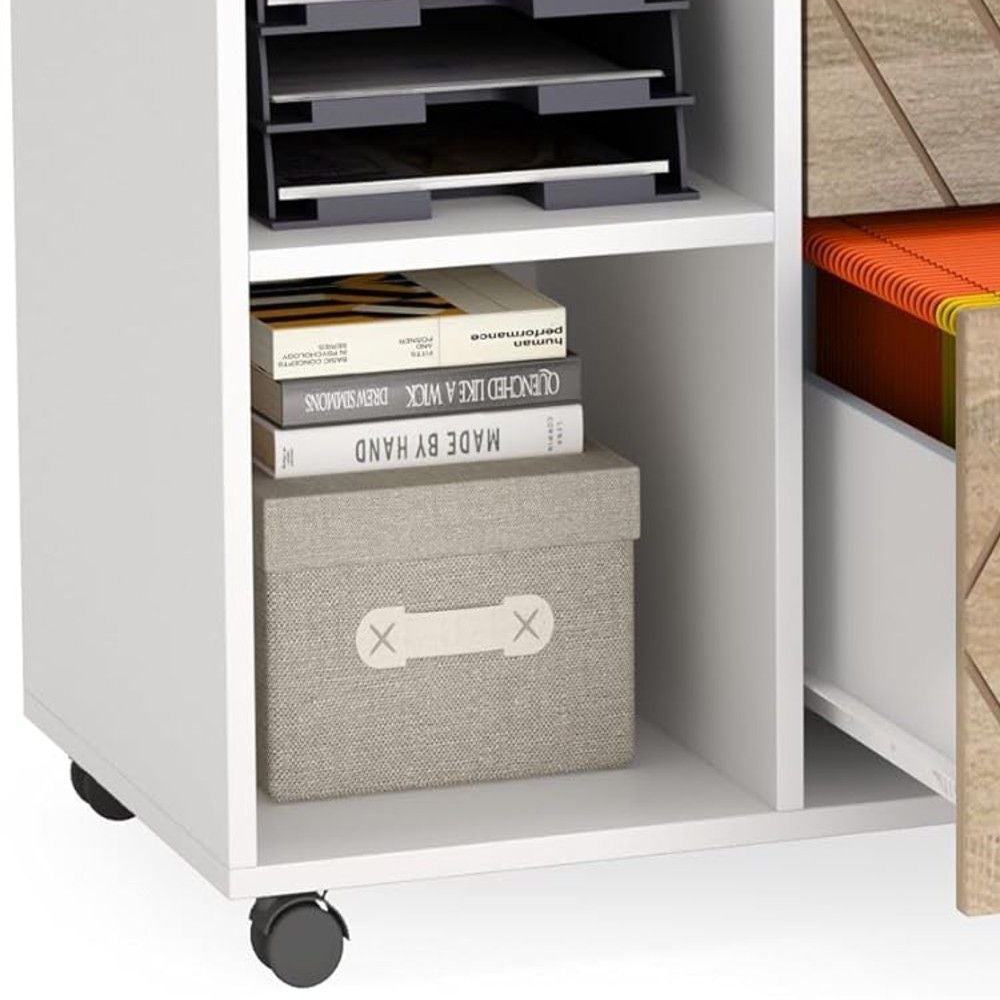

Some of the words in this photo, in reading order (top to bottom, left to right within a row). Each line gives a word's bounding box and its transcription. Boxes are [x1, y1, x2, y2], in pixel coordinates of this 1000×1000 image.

[399, 336, 433, 345] POSNER
[470, 326, 563, 341] performance
[513, 337, 563, 348] human
[282, 350, 336, 360] PSYCHOLOGY
[318, 342, 347, 350] SERIES
[277, 358, 322, 367] CONCEPTS
[324, 356, 347, 365] BASIC
[444, 381, 456, 403] A
[459, 379, 485, 403] LIKE
[487, 368, 560, 400] QUENCHED
[304, 389, 357, 412] SIMMONS
[358, 386, 388, 407] DREW
[405, 382, 443, 408] WICK
[355, 435, 408, 463] HAND
[415, 433, 439, 458] BY
[447, 428, 501, 456] MADE
